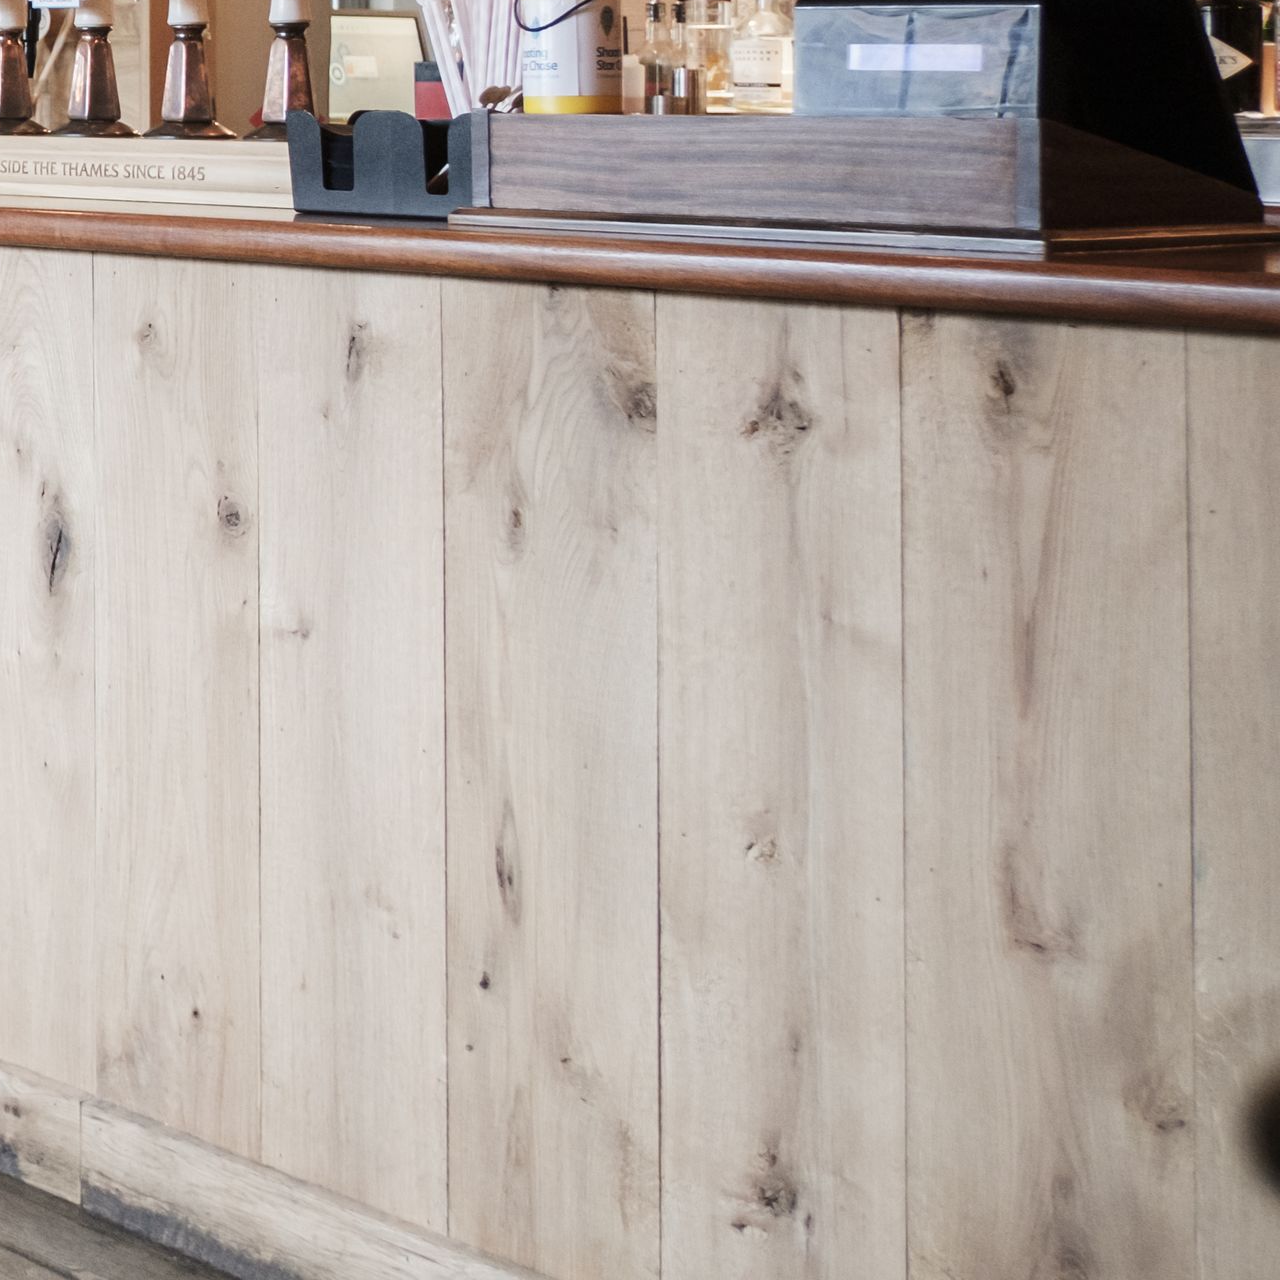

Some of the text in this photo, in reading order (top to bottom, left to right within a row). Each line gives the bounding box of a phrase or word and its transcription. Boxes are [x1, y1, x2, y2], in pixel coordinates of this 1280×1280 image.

[32, 161, 58, 176] THE
[60, 162, 120, 178] THAMES
[122, 164, 166, 180] SINCE
[170, 165, 206, 182] 1845
